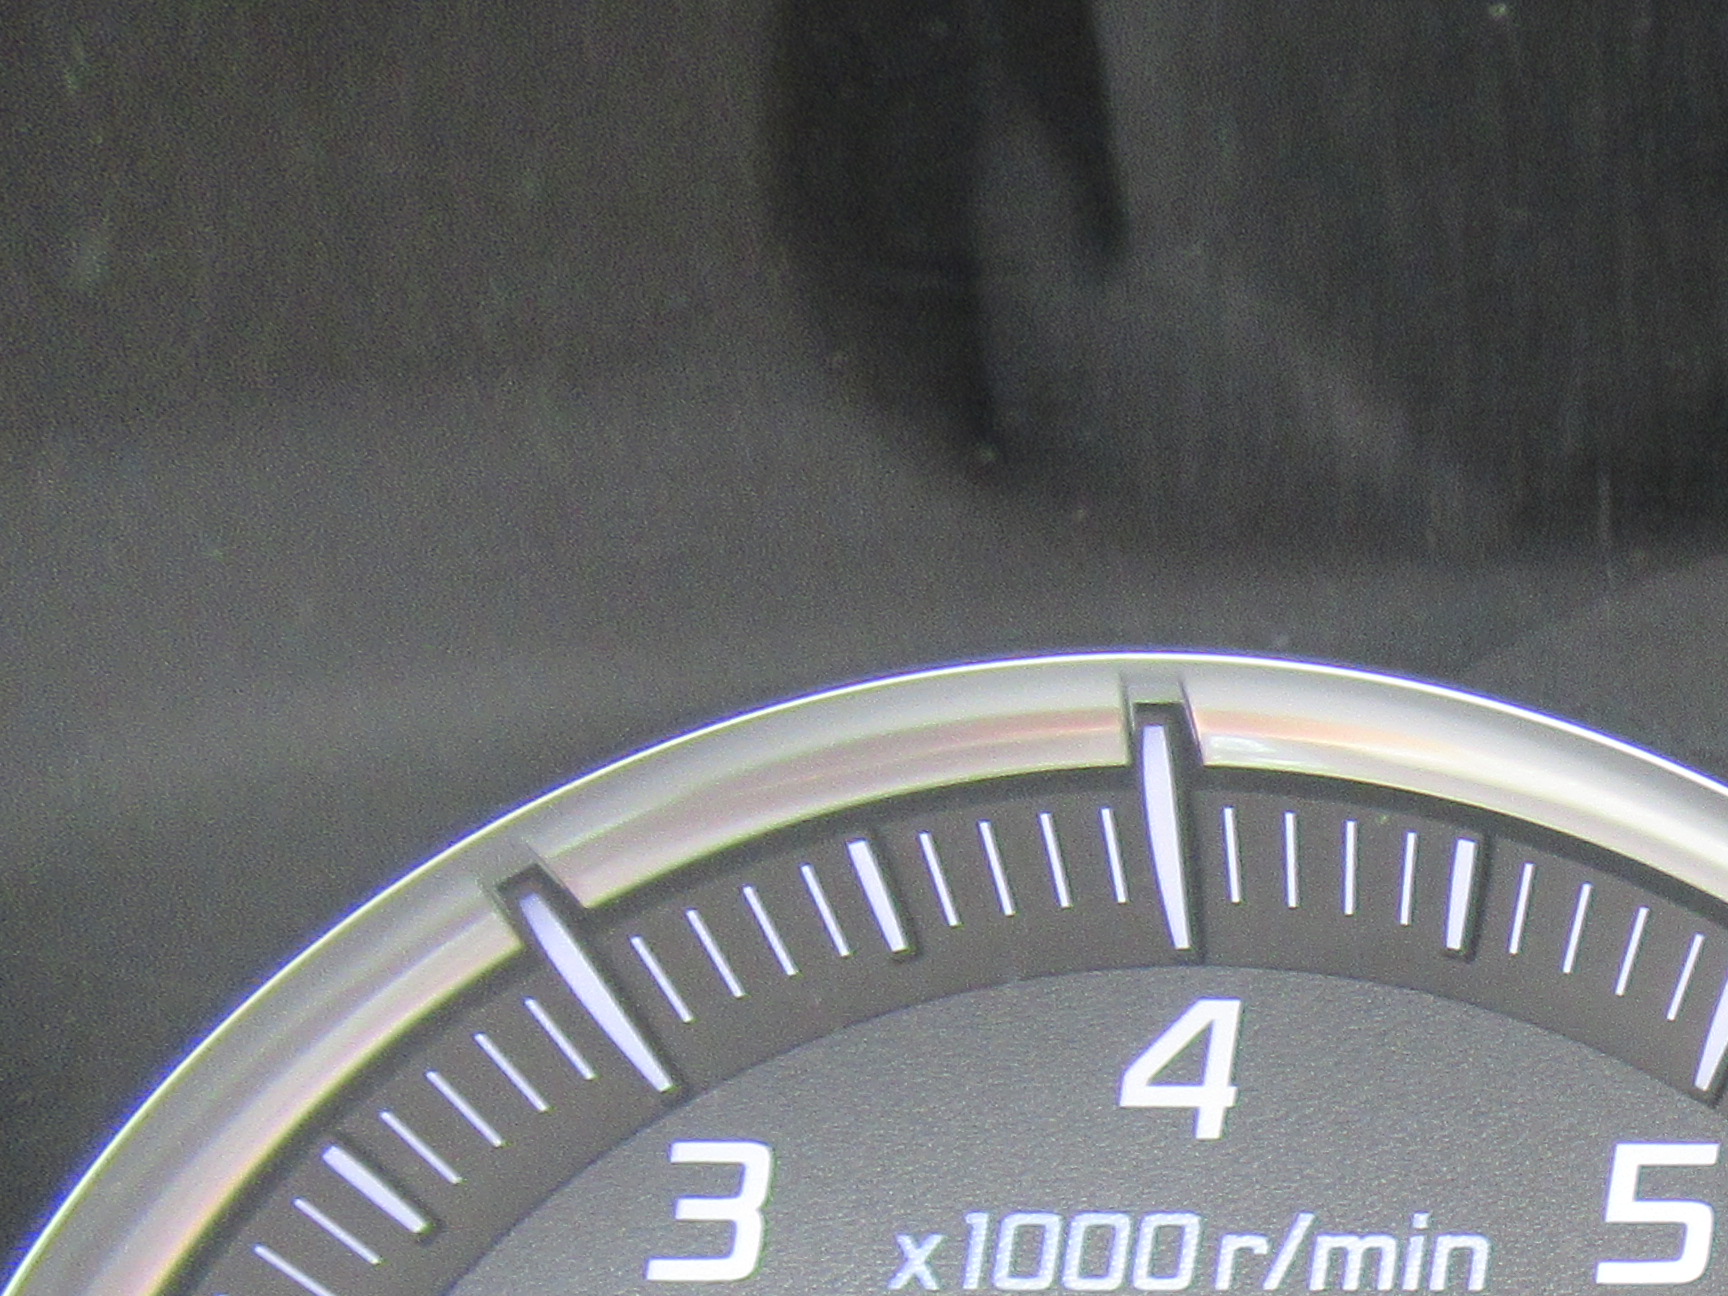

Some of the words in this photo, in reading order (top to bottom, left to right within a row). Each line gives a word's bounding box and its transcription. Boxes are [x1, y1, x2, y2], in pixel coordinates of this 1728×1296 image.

[1118, 998, 1243, 1141] 4
[645, 1140, 774, 1283] 3
[1594, 1142, 1721, 1286] 5
